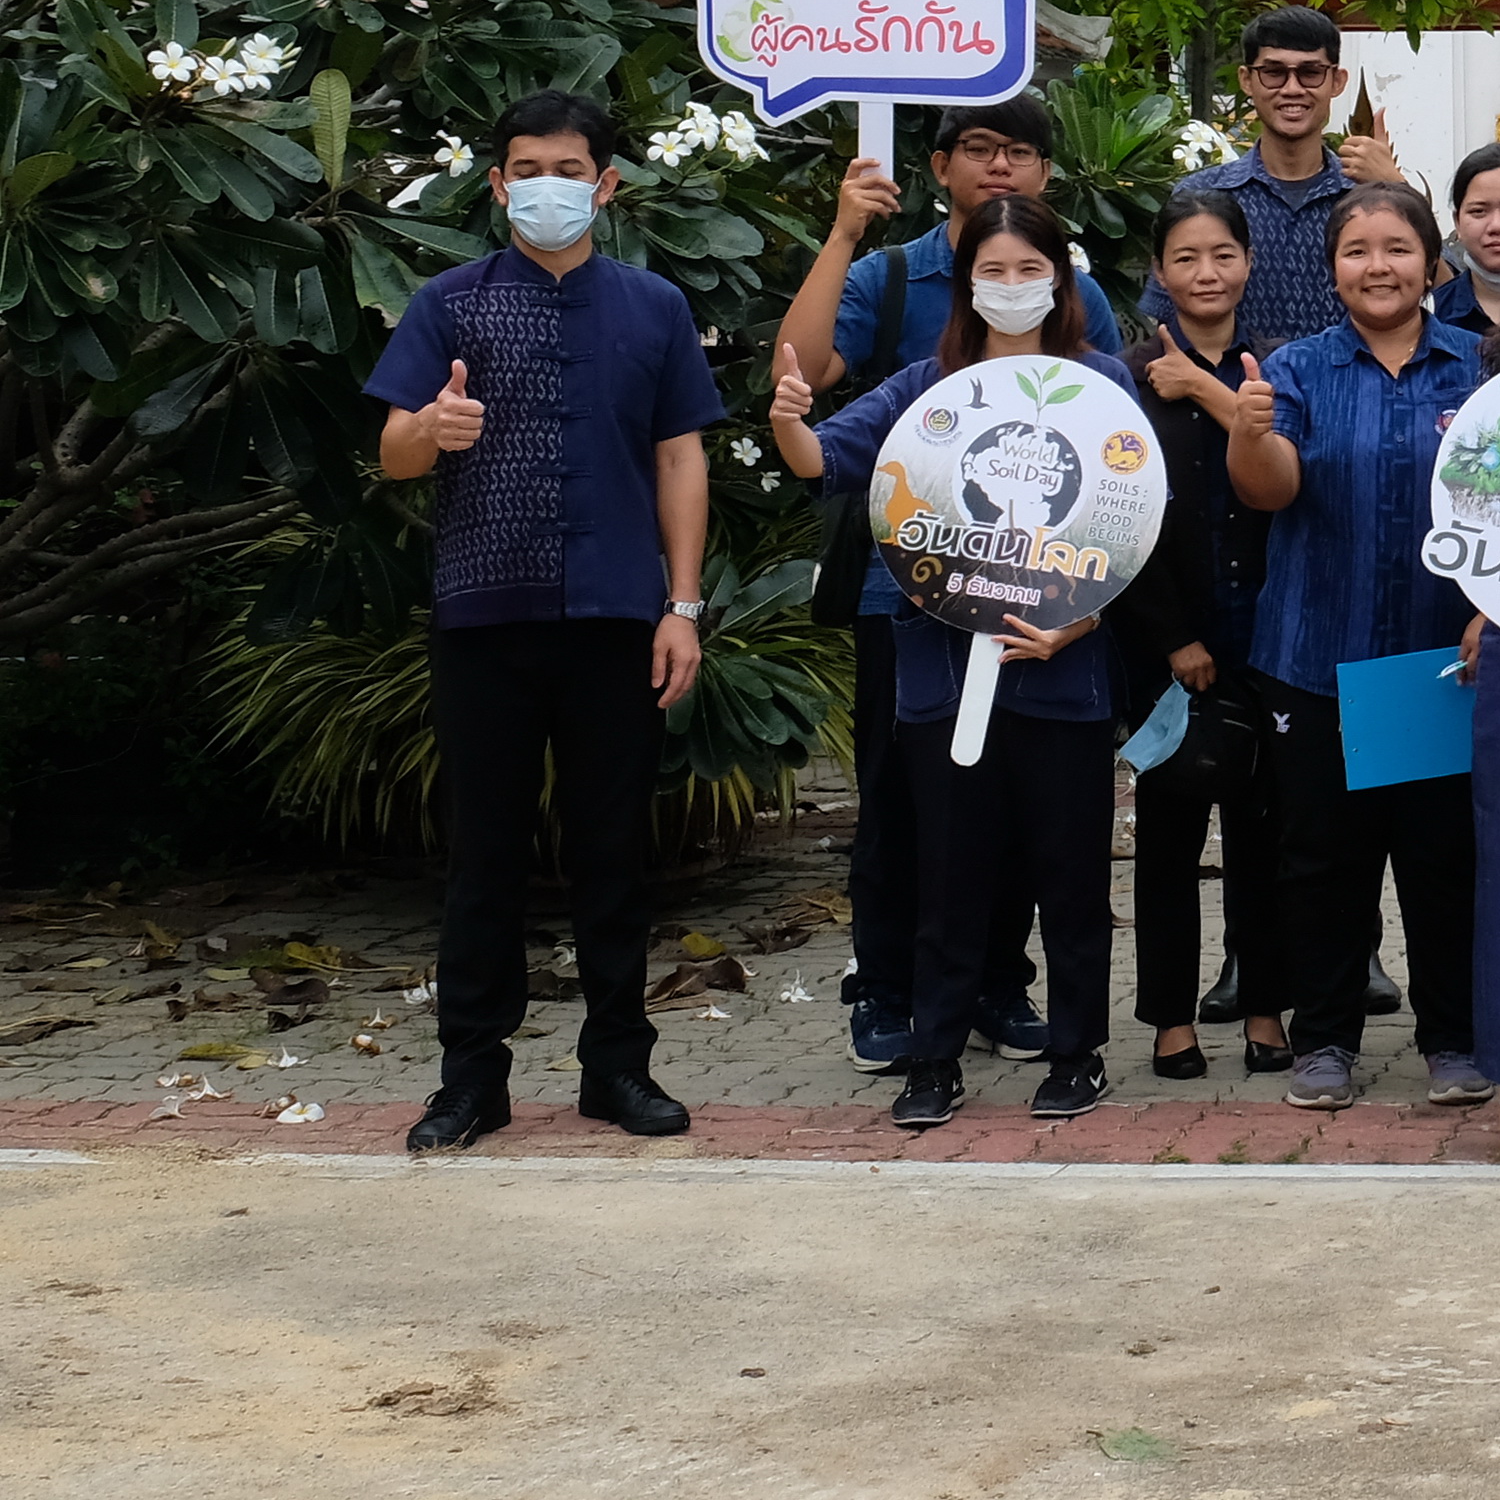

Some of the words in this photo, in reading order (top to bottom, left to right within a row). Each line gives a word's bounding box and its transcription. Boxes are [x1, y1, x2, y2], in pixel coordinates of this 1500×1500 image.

[750, 0, 996, 69] ผู้คนรักกัน
[1003, 440, 1055, 464] World
[986, 459, 1020, 480] Soil
[1023, 464, 1060, 492] Day
[1096, 494, 1147, 515] WHERE
[1091, 510, 1133, 528] FOOD
[899, 510, 1109, 581] วันดินโลก
[1088, 527, 1141, 546] BEGINS
[947, 574, 963, 592] 5
[966, 576, 1041, 606] ธันวาคม
